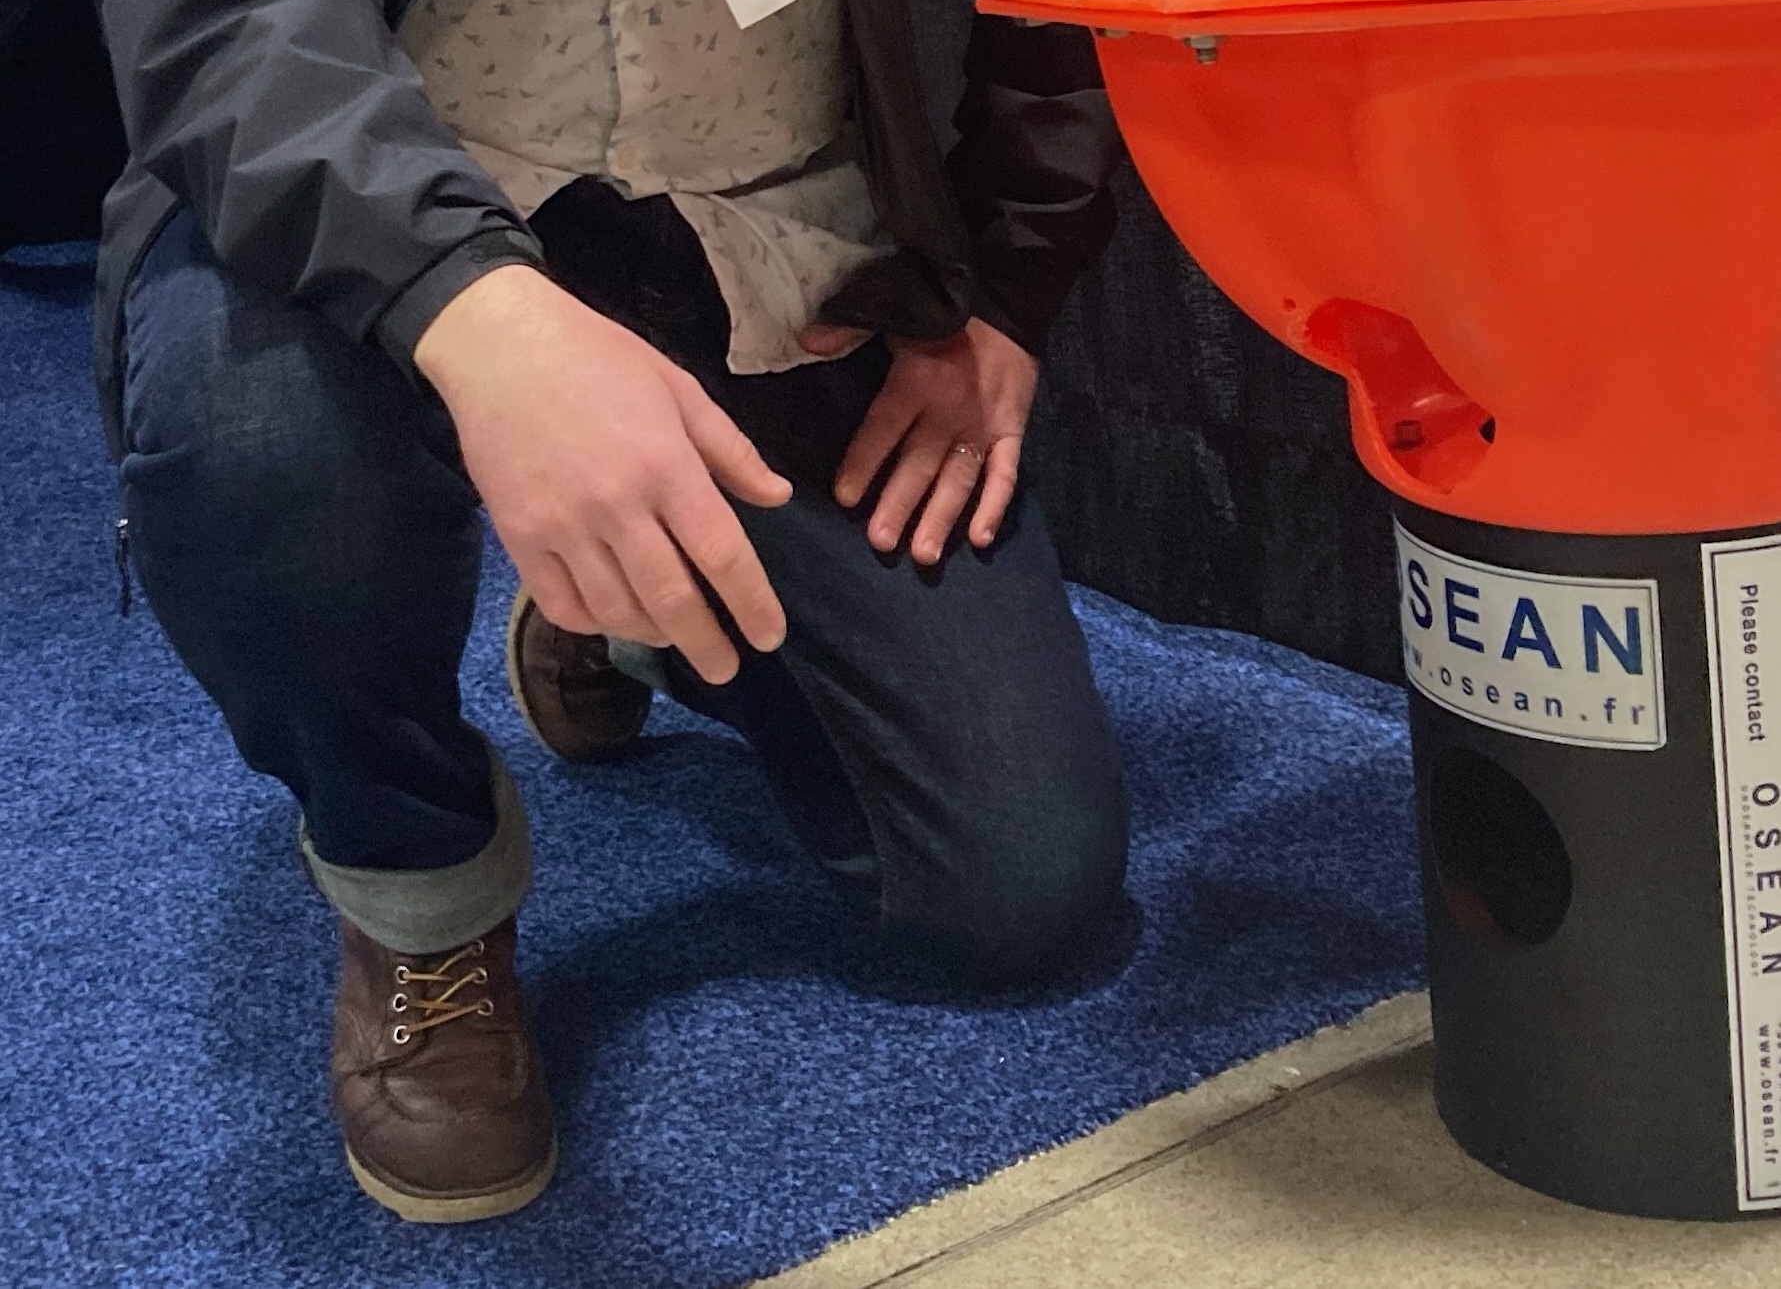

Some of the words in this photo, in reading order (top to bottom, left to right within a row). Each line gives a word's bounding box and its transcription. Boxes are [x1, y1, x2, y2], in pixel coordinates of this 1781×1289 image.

[1403, 558, 1644, 676] SEAN
[1740, 584, 1759, 655] Please
[1744, 663, 1766, 742] contact
[1752, 782, 1781, 975] OSEAN
[1758, 1024, 1779, 1164] www.osean.fr
